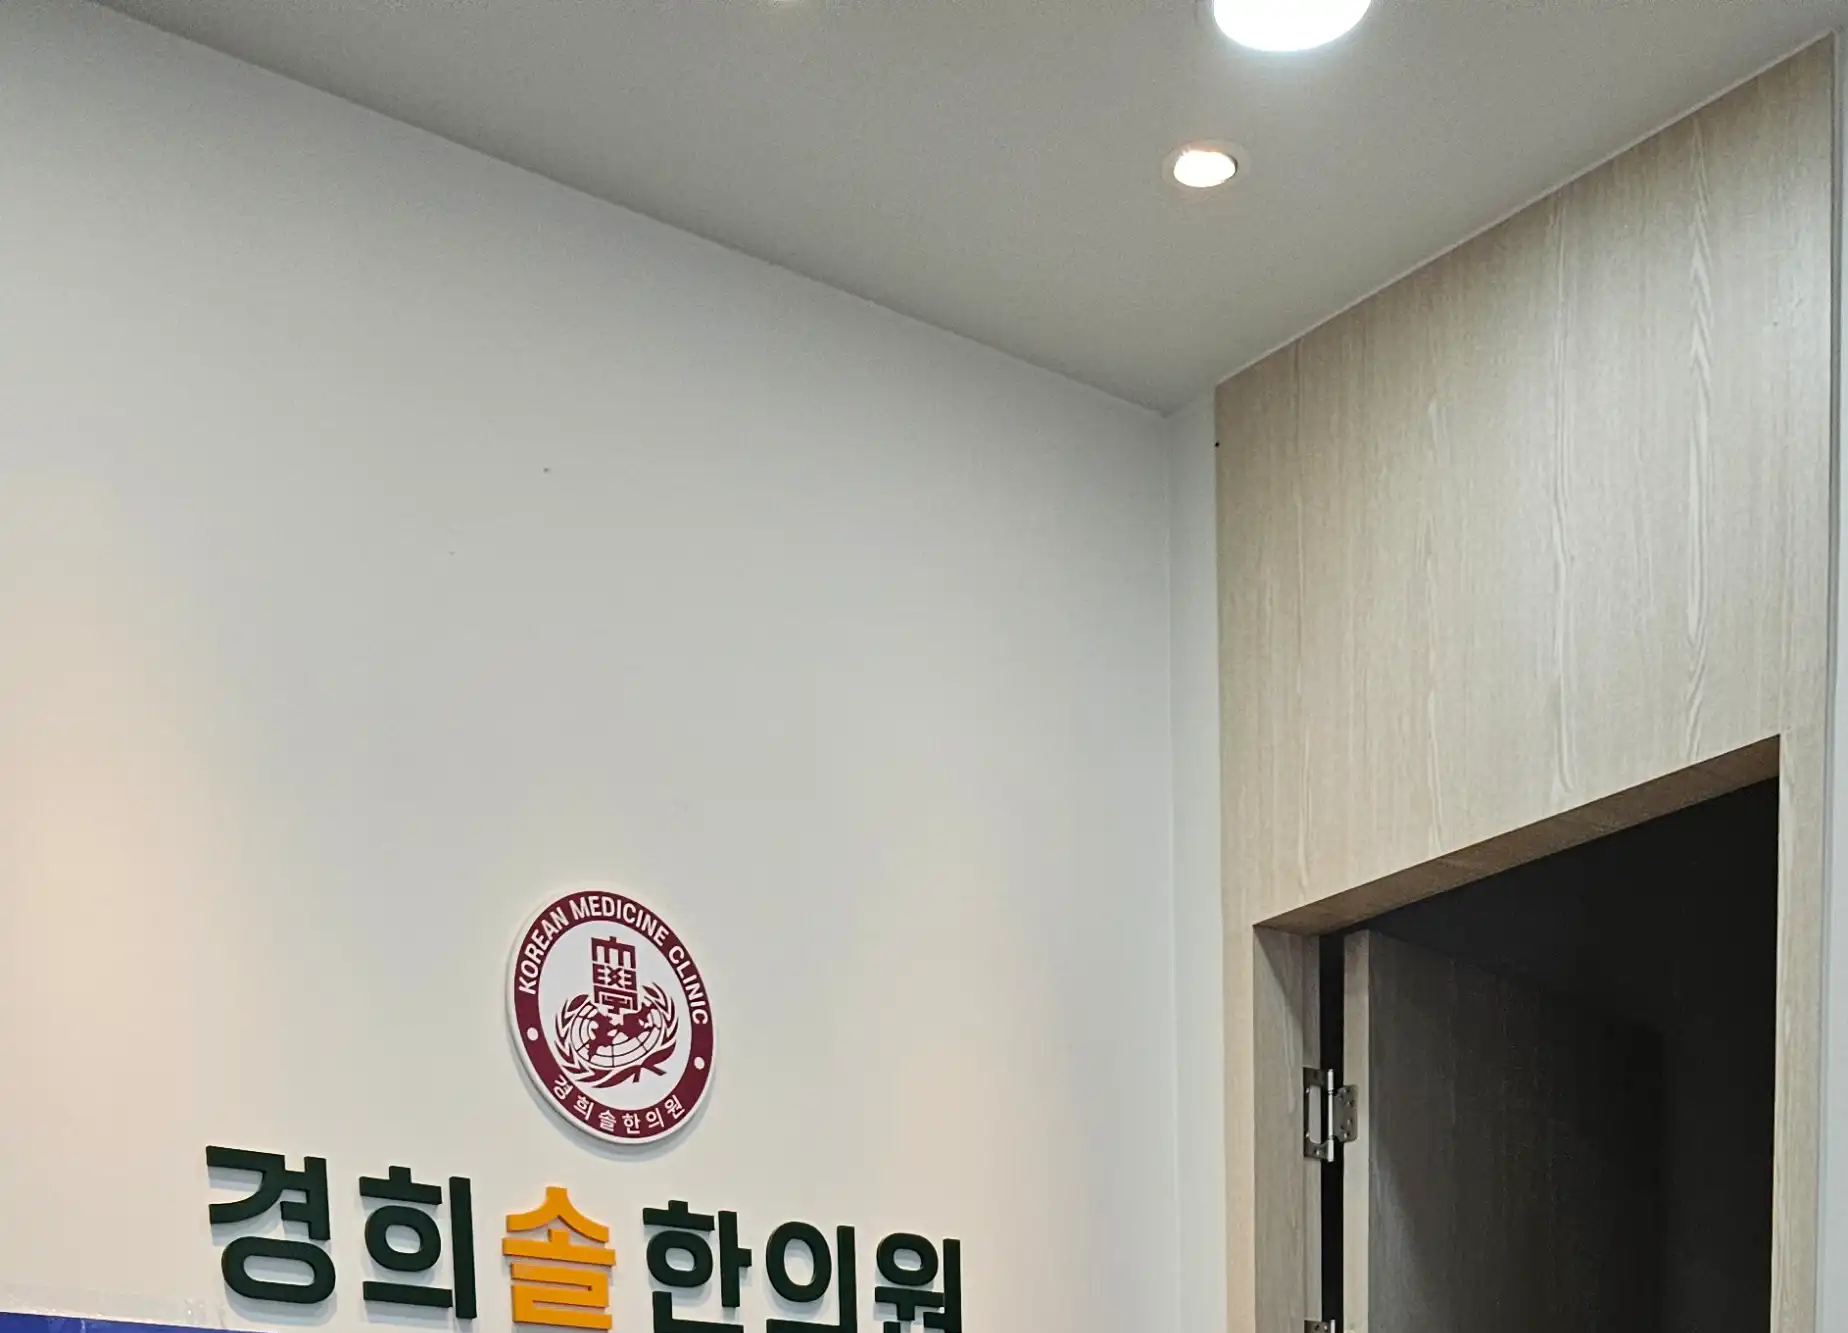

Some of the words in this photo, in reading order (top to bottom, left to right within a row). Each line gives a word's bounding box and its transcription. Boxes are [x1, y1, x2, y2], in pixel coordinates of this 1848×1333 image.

[519, 907, 569, 994] KOREAN
[569, 895, 669, 946] MEDICINE
[668, 945, 708, 1025] CLINIC
[553, 1074, 685, 1135] 경희솔한의원
